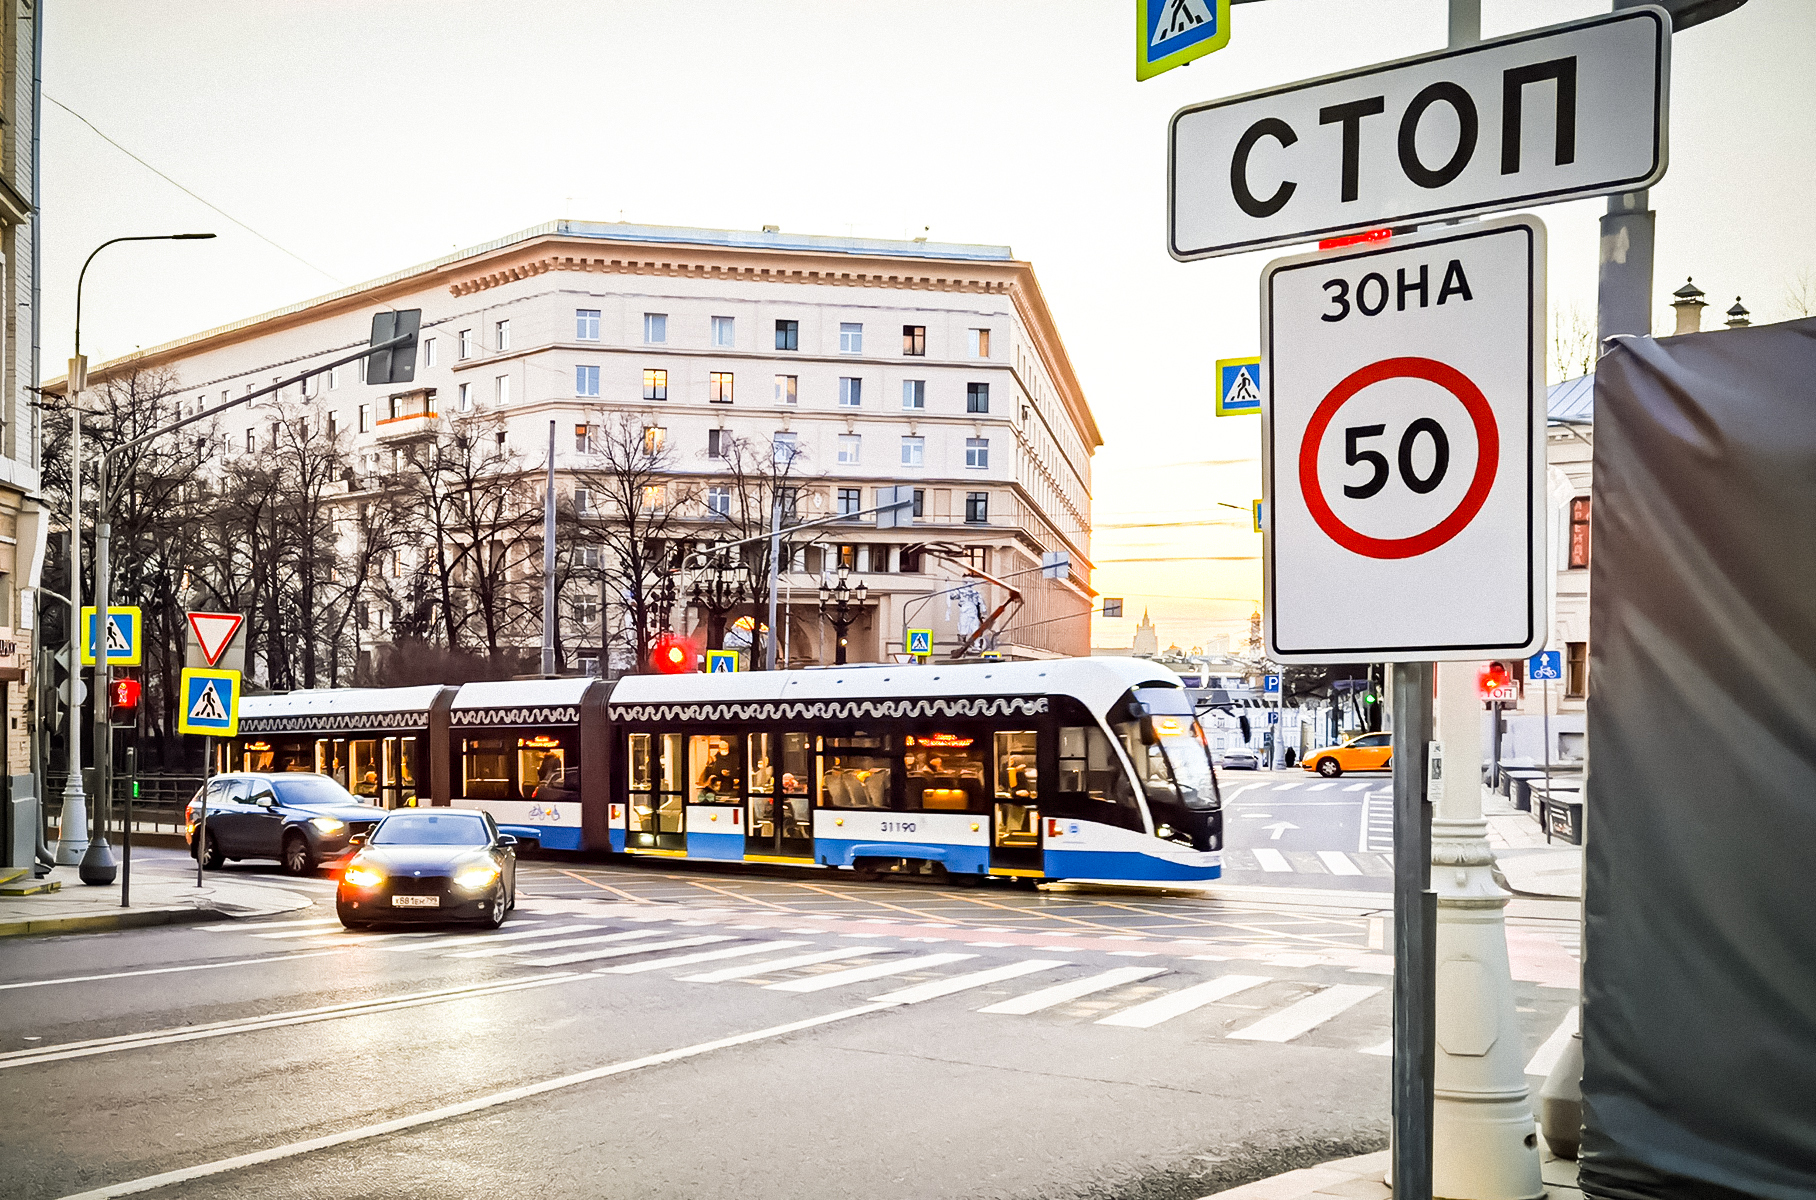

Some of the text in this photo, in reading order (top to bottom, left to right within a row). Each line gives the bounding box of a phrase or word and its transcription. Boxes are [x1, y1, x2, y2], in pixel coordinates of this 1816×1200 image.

[1231, 56, 1577, 217] СТОП
[1320, 259, 1474, 322] ЗОНА
[1343, 417, 1450, 499] 50
[1480, 688, 1512, 698] ТОП
[881, 821, 916, 832] 31190
